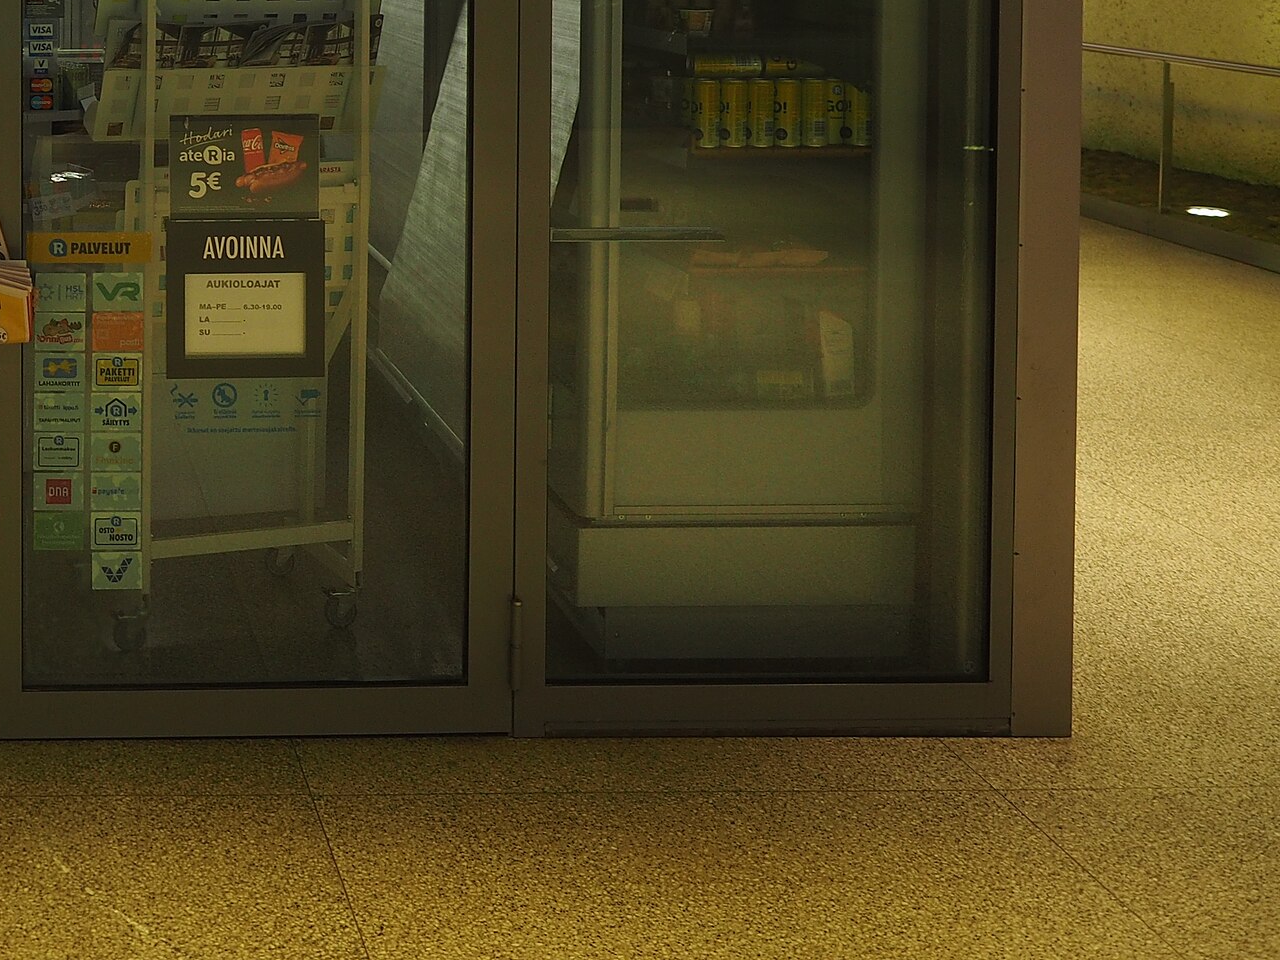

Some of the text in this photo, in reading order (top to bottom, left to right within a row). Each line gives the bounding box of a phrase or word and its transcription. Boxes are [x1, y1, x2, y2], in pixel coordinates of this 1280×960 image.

[30, 24, 53, 36] VISA
[30, 41, 53, 53] VISA
[179, 124, 233, 146] Hodari
[188, 170, 222, 199] 5€
[70, 241, 131, 256] PALVELUT
[202, 235, 285, 260] AVOINNA
[65, 284, 84, 293] HSL
[206, 279, 282, 290] AUKIOLOAJAT
[96, 281, 141, 302] VR
[198, 302, 228, 311] MA-PE
[198, 316, 211, 324] LA
[198, 329, 211, 337] SU
[99, 367, 135, 377] PAKETTI
[102, 418, 130, 426] SÄILYTYS
[48, 487, 69, 497] DNA
[109, 533, 134, 542] NOSTO
